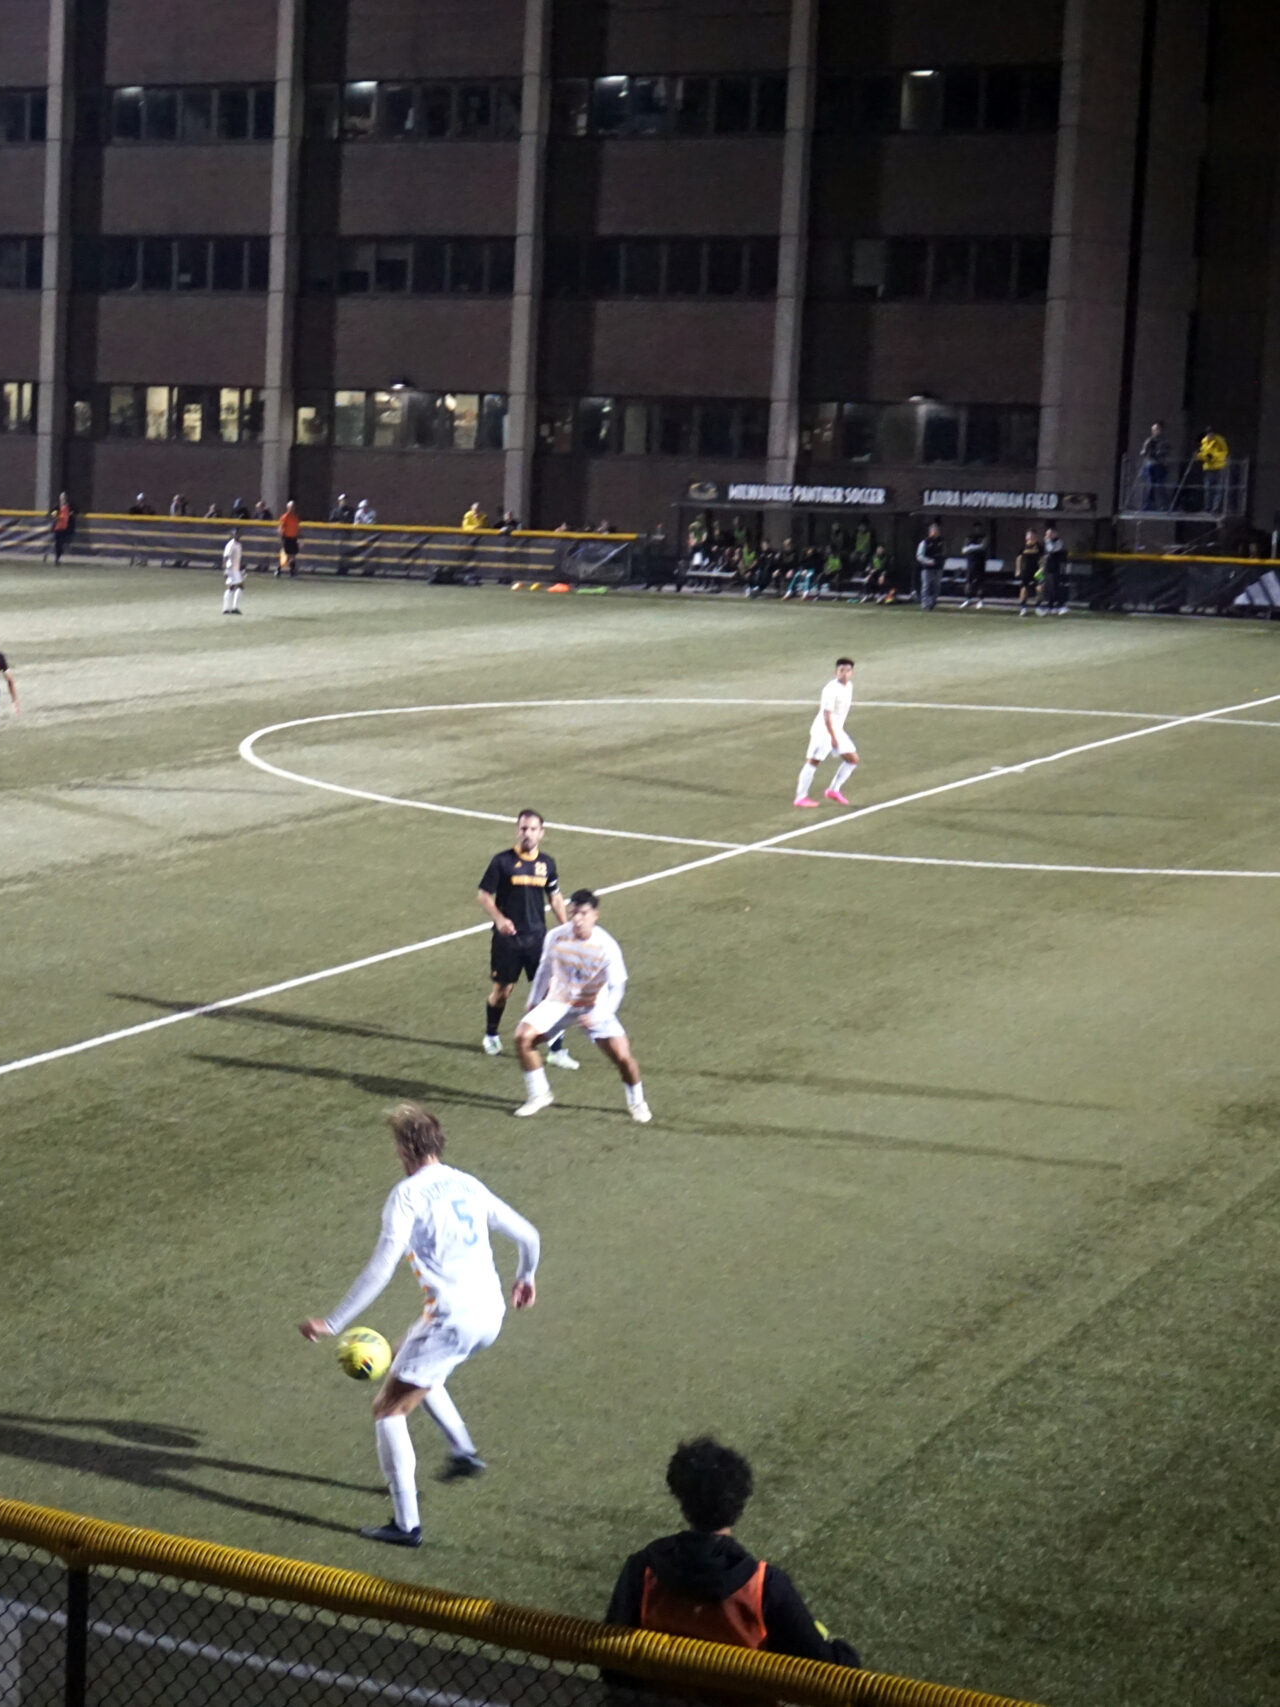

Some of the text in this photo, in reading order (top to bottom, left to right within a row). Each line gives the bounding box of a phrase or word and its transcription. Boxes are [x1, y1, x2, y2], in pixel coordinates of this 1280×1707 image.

[793, 485, 844, 502] PANTHER
[844, 487, 886, 504] SOCCER
[922, 490, 960, 506] LAURA
[1024, 493, 1058, 509] FIELD
[451, 1198, 478, 1247] 5
